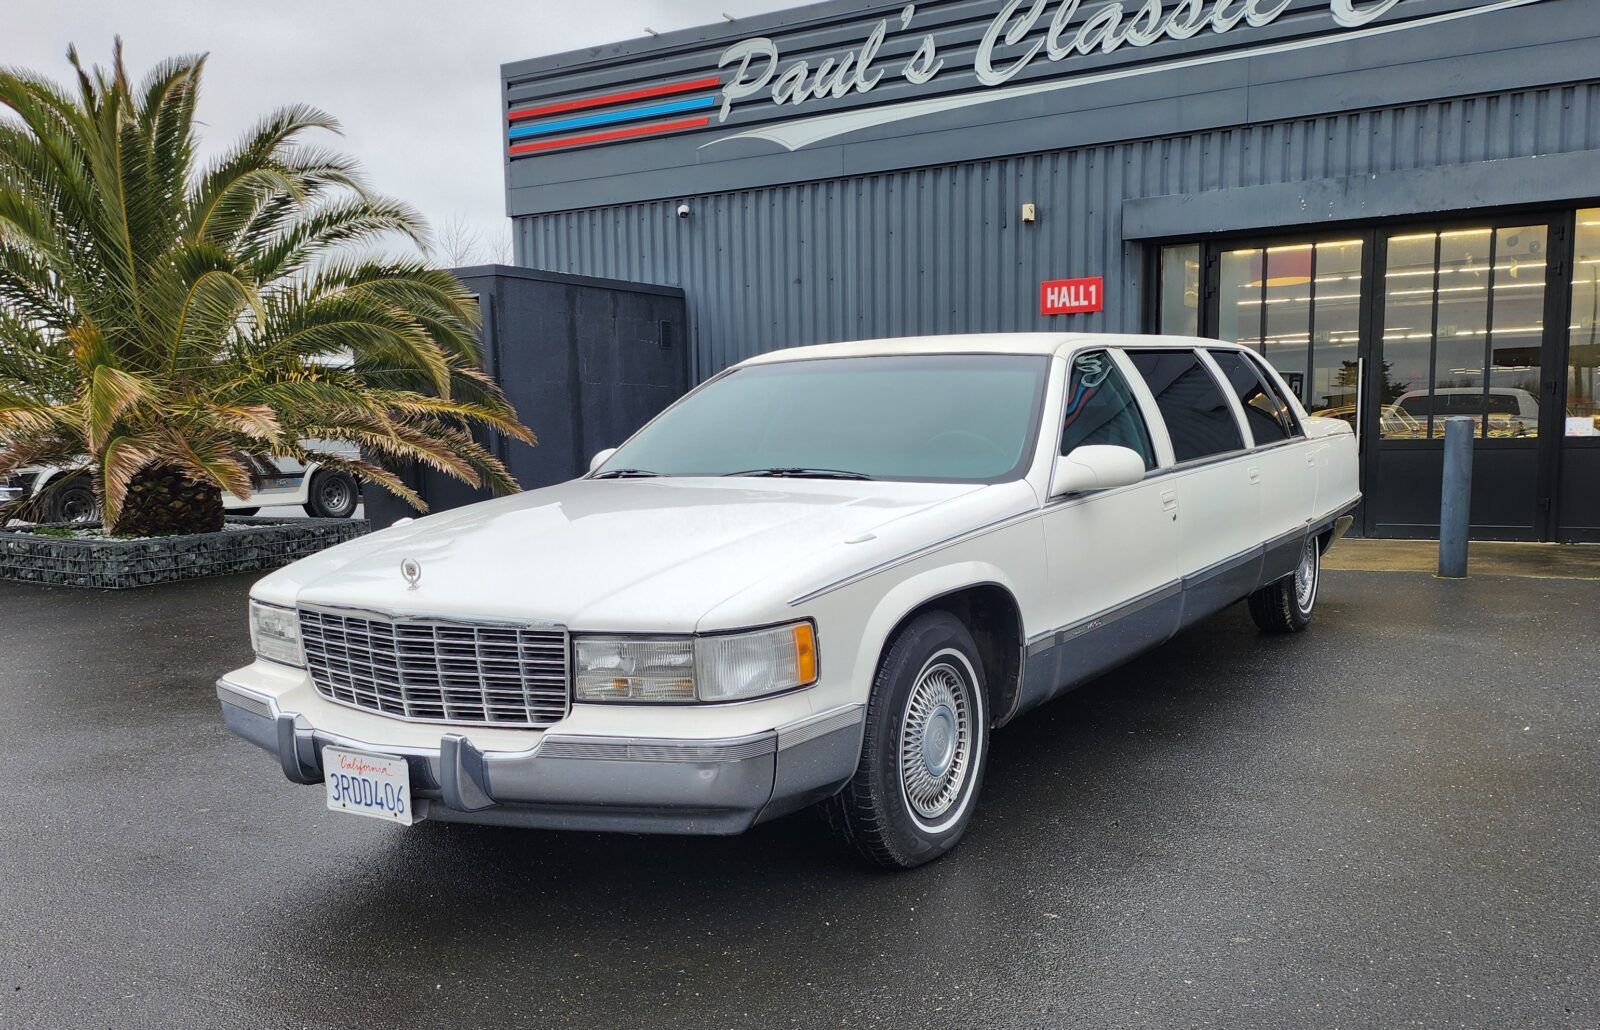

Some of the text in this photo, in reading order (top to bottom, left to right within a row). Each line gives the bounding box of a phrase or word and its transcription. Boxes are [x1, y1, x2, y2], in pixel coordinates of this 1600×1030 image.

[718, 3, 944, 122] Paul's
[340, 755, 393, 776] California
[330, 773, 404, 813] 3RDD406
